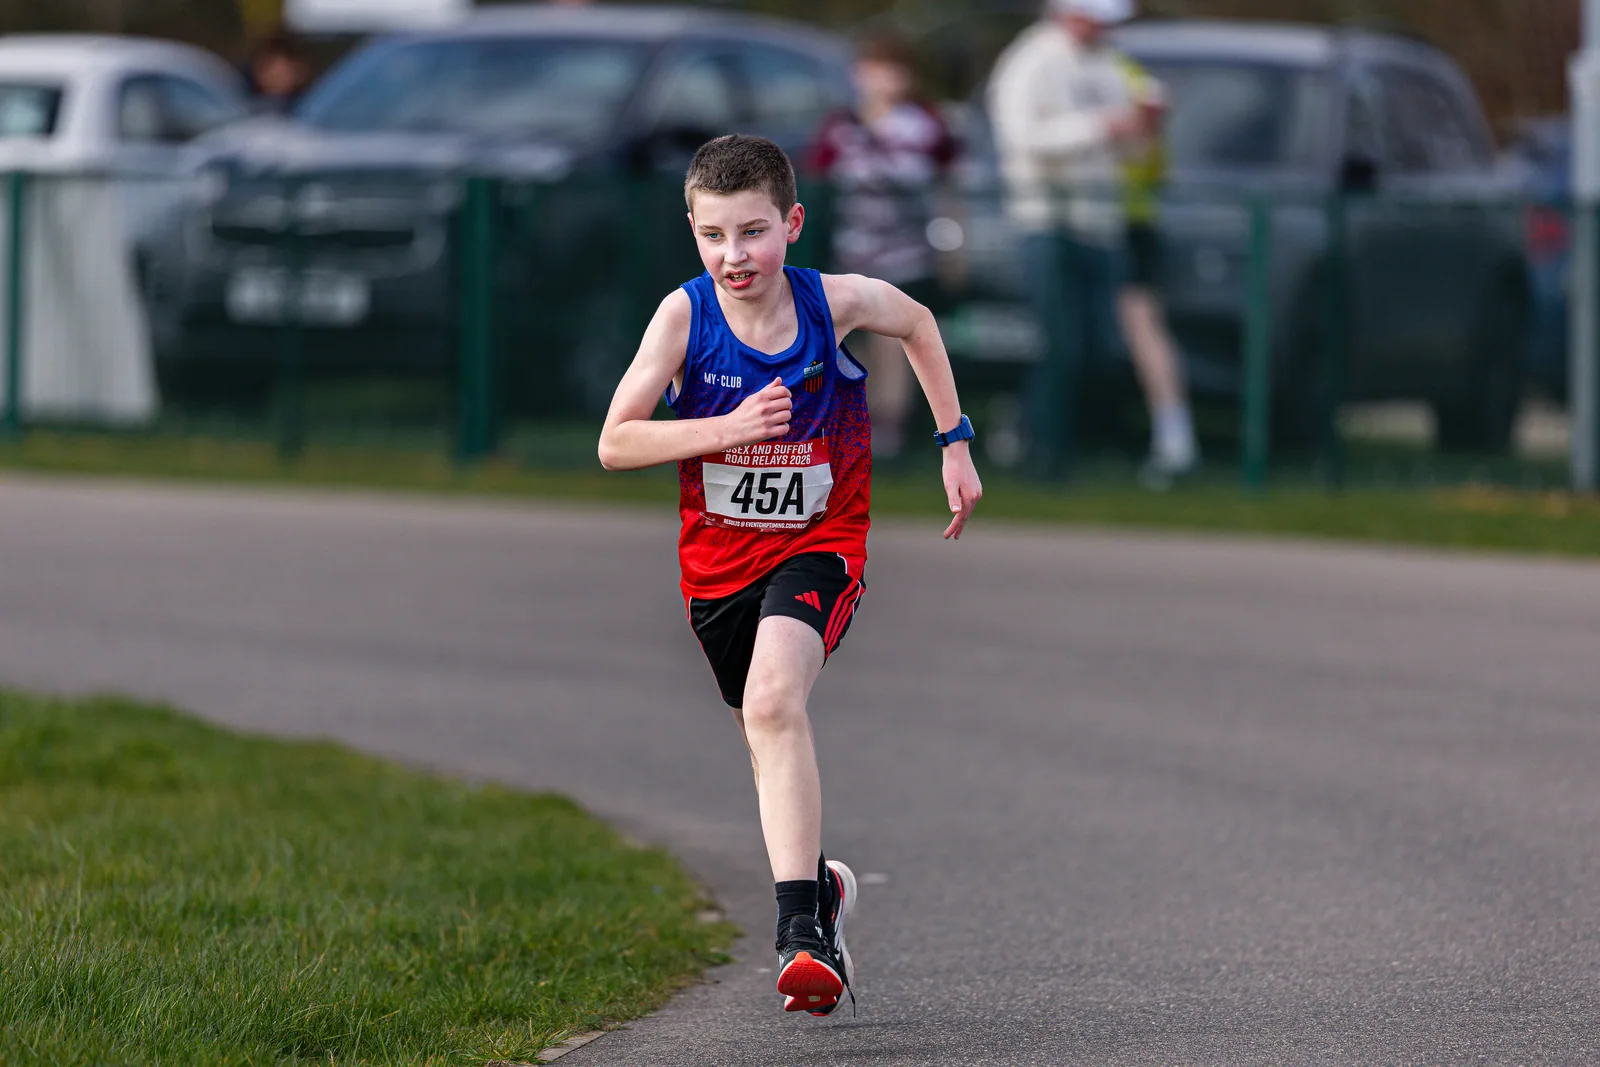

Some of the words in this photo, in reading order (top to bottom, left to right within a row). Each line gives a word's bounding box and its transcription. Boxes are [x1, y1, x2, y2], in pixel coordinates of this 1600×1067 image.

[750, 444, 772, 454] AND
[773, 443, 813, 454] SUFFOLK
[725, 454, 750, 465] ROAD
[752, 455, 788, 465] RELAYS
[789, 454, 811, 465] 2026
[730, 472, 804, 515] 45A
